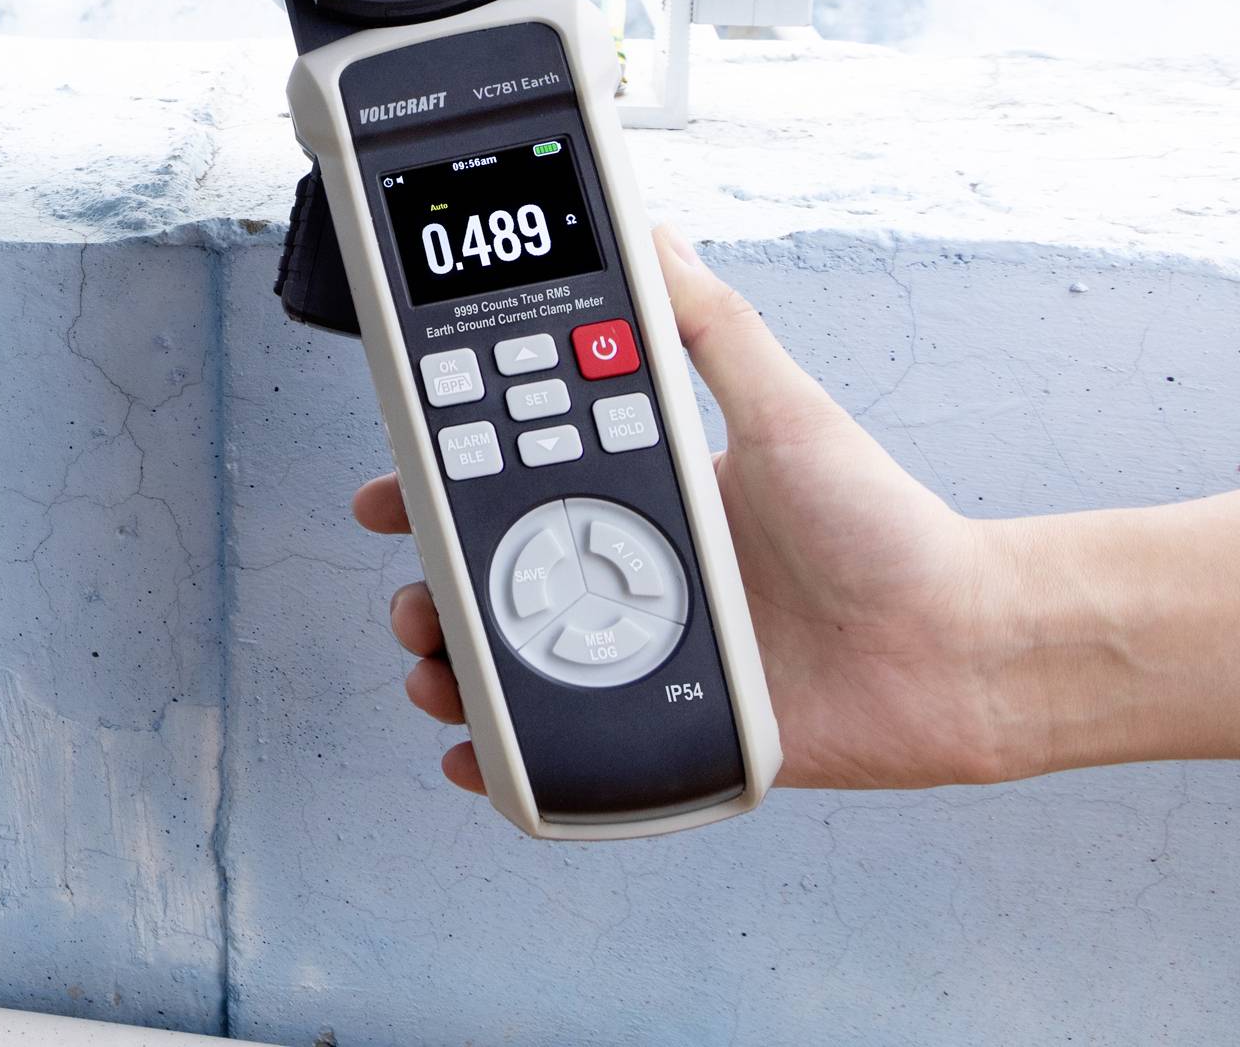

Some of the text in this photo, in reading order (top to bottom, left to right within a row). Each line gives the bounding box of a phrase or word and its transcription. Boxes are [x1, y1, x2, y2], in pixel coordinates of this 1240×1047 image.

[472, 72, 560, 100] VC781 Earth
[360, 92, 447, 124] VOLTCRAFT
[452, 155, 497, 171] 09:56am
[430, 203, 448, 212] Auto
[421, 204, 552, 275] 0.489
[454, 285, 571, 318] 9999 Counts True RMS
[426, 296, 604, 339] Earth Ground Current Clamp Meter
[440, 360, 457, 373] OK
[441, 377, 465, 393] BPF
[525, 391, 549, 406] SET
[609, 407, 636, 422] ESC
[608, 422, 645, 439] HOLD
[447, 433, 490, 451] ALARM
[460, 451, 484, 466] BLE
[514, 567, 546, 583] SAVE
[584, 631, 616, 647] MEM
[590, 647, 618, 661] LOG
[665, 682, 704, 703] IP54
